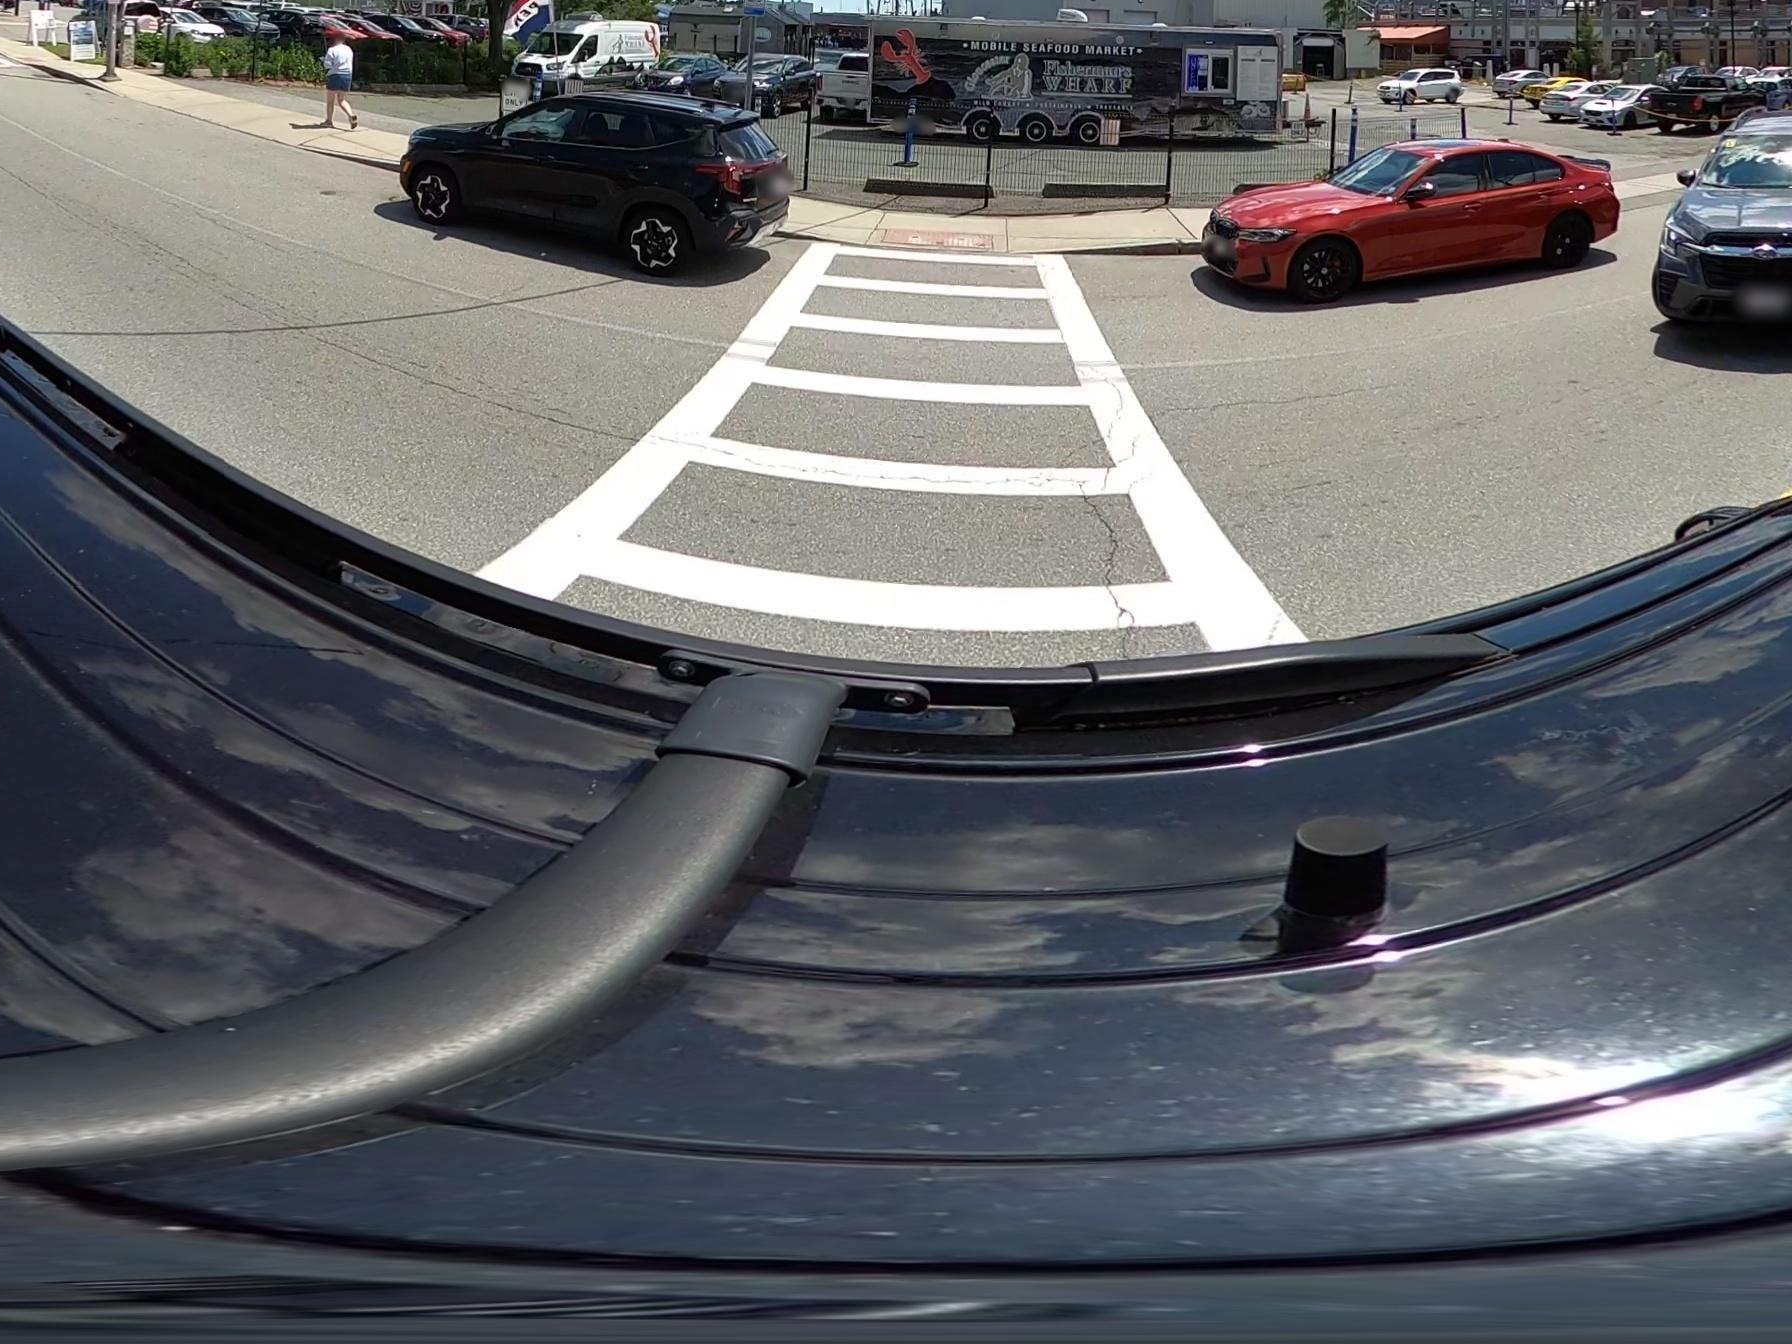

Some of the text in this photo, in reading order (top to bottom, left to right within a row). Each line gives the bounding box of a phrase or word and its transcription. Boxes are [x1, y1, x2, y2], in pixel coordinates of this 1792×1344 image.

[970, 41, 1135, 55] MOBILE SEAFOOD MARKET
[1042, 76, 1133, 93] WHARF
